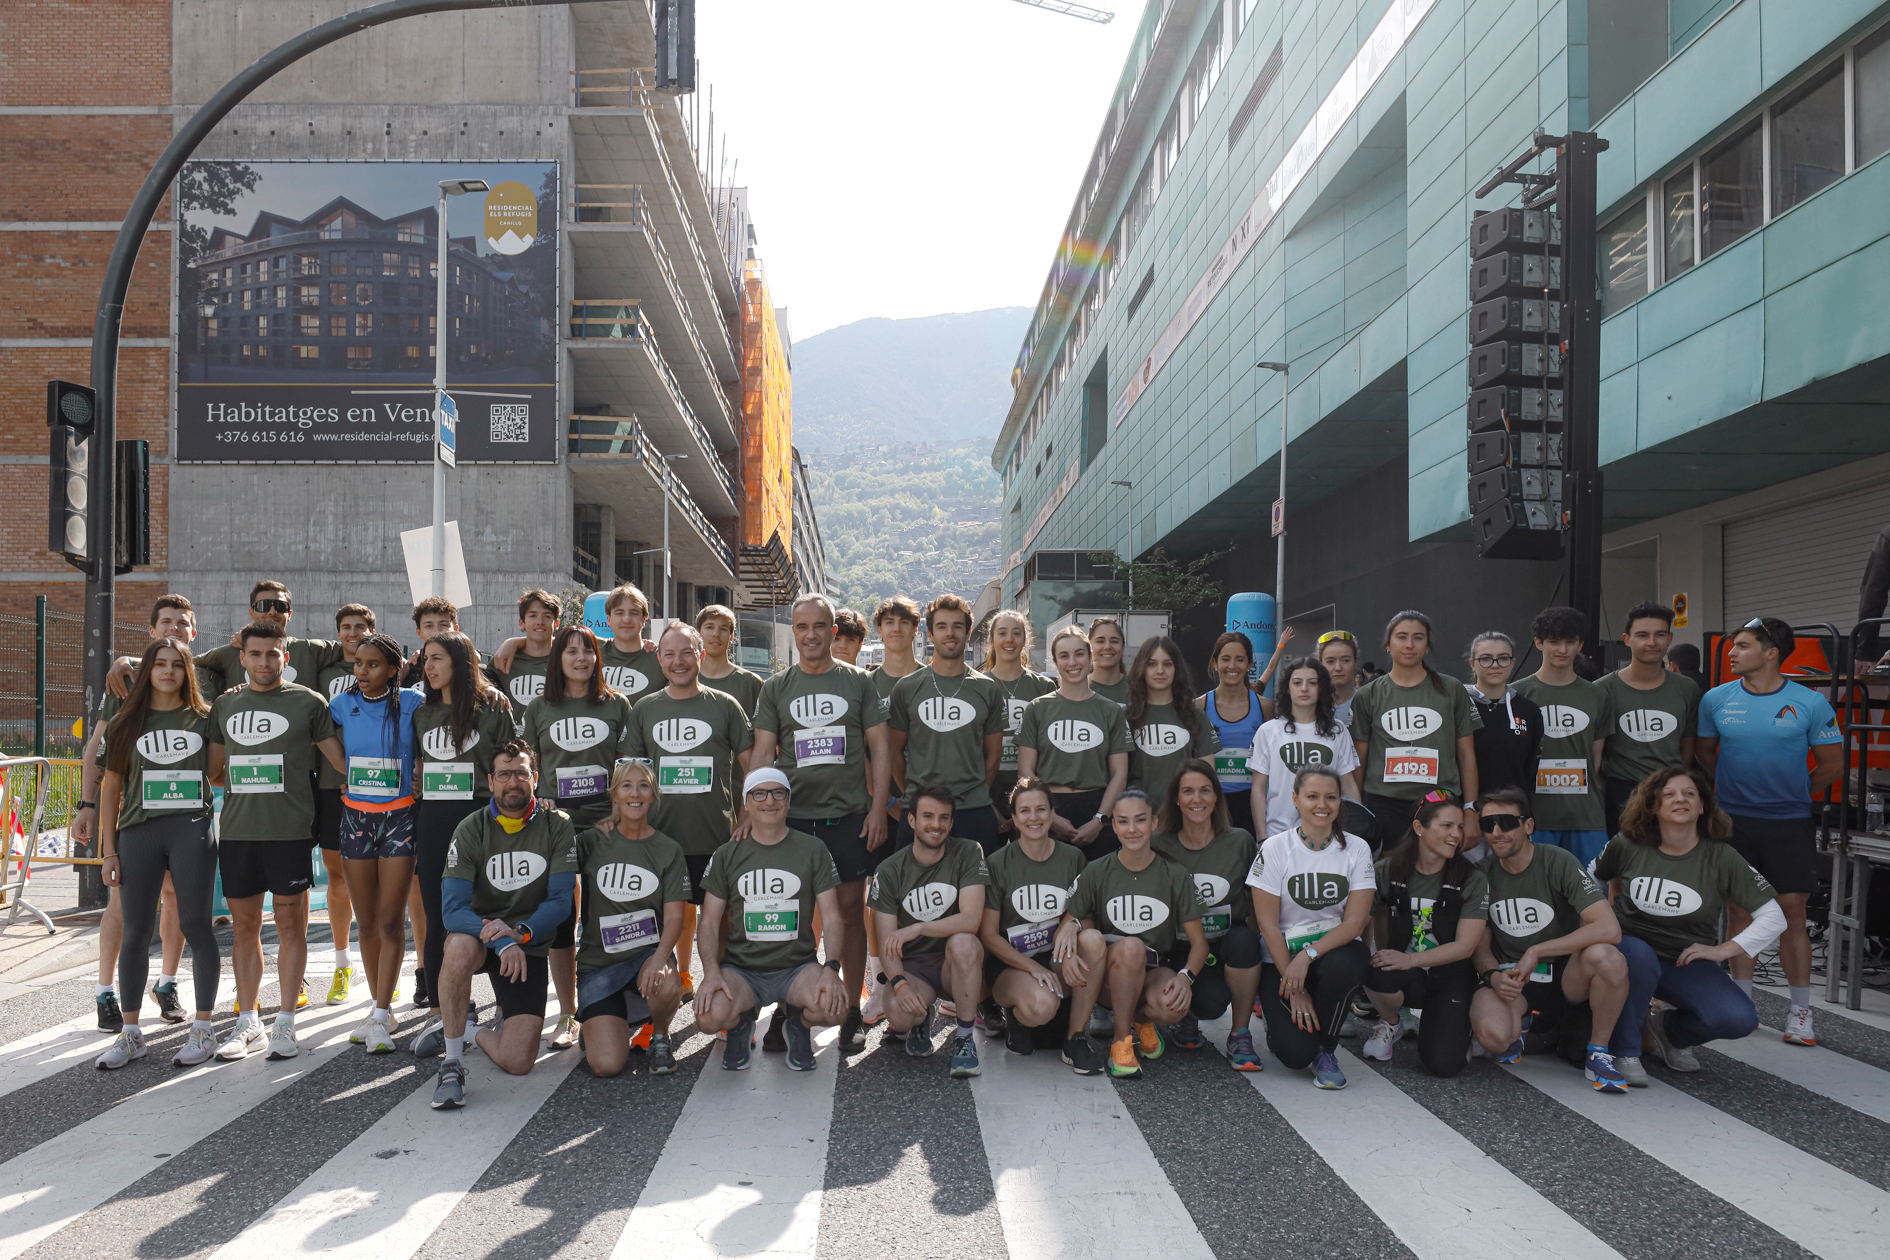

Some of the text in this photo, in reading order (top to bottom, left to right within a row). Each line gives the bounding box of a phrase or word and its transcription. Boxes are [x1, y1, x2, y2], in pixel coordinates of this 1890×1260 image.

[1232, 214, 1250, 256] NXT
[206, 402, 339, 428] Habitatges
[346, 408, 377, 422] en
[440, 409, 455, 433] TAXI
[215, 431, 249, 442] +376
[251, 431, 277, 442] 615
[279, 431, 305, 442] 616
[515, 675, 546, 695] illa
[604, 666, 635, 688] illa
[796, 694, 834, 718] illa
[925, 697, 961, 721] illa
[232, 711, 271, 734] illa
[555, 716, 596, 741] illa
[658, 718, 697, 741] illa
[1388, 706, 1427, 731] illa
[1626, 709, 1664, 732] illa
[144, 730, 188, 754] illa
[1054, 720, 1091, 743] illa
[807, 738, 834, 749] 2383
[810, 748, 831, 756] ALAIN
[1285, 742, 1322, 764] illa
[252, 767, 258, 775] 1
[677, 768, 695, 777] 251
[1227, 758, 1234, 767] 6
[1393, 762, 1429, 775] 4198
[241, 776, 270, 784] NAHUEL
[367, 770, 381, 779] 97
[445, 774, 451, 783] 7
[571, 777, 595, 788] 2108
[672, 777, 699, 785] XAVIER
[1544, 774, 1580, 787] 1002
[162, 791, 184, 799] ALBA
[169, 782, 177, 791] 8
[569, 787, 598, 796] MONICA
[491, 852, 530, 880] illa
[602, 863, 643, 892] illa
[744, 869, 784, 896] illa
[1295, 872, 1339, 899] illa
[908, 883, 944, 908] illa
[1018, 884, 1058, 910] illa
[1635, 876, 1682, 908] illa
[764, 913, 779, 923] 99
[1113, 895, 1153, 921] illa
[1496, 898, 1539, 925] illa
[615, 929, 646, 943] SANDRA
[618, 923, 641, 936] 2211
[1023, 929, 1049, 943] 2599
[1026, 938, 1049, 949] SILVIA
